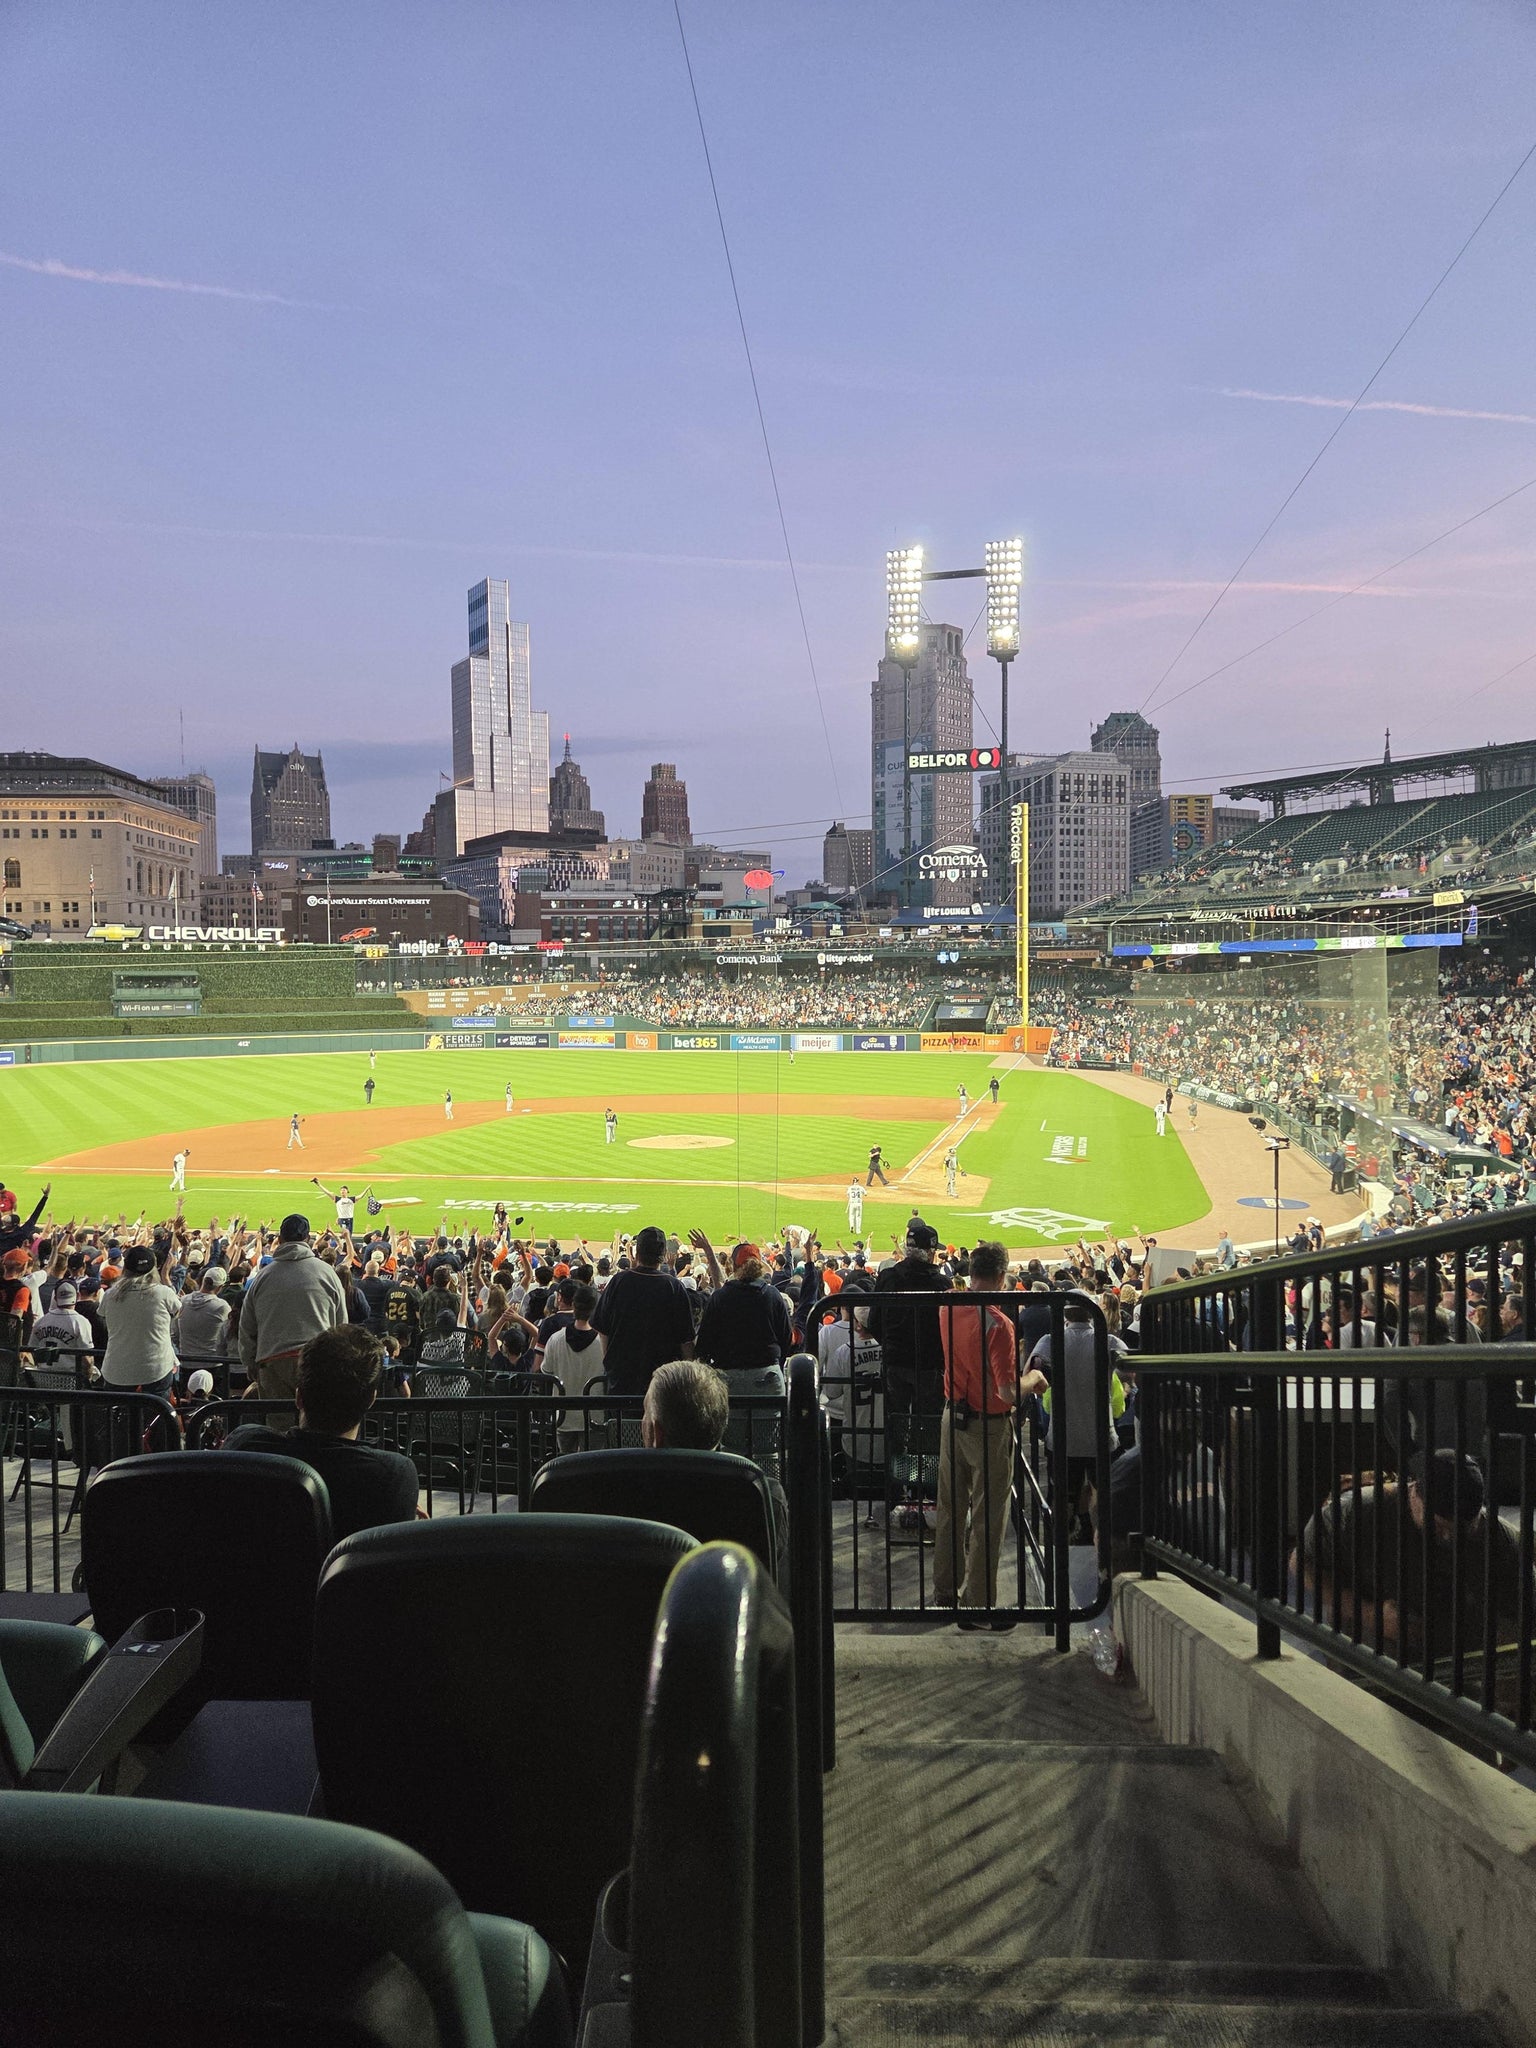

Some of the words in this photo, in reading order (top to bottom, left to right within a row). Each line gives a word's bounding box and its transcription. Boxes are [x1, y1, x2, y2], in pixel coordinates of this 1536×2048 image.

[909, 753, 968, 768] BELFOR
[1011, 819, 1022, 865] Rocket
[269, 862, 289, 871] Ashley
[342, 897, 367, 905] VALLEY
[367, 897, 388, 905] STATE
[389, 897, 431, 905] UNIVERSITY
[940, 907, 971, 916] LOUNGE
[1276, 906, 1297, 916] CLUB
[149, 926, 285, 941] CHEVROLET
[122, 943, 266, 951] FOUNTAIN
[399, 940, 441, 956] meijer
[546, 949, 564, 957] LAW
[759, 953, 783, 963] Bank
[446, 1035, 483, 1043] FERRIS
[635, 1036, 649, 1047] hop
[674, 1037, 717, 1048] bet365
[747, 1036, 776, 1044] McLaren
[802, 1037, 832, 1050] meijer
[923, 1038, 951, 1047] PIZZA
[851, 1191, 860, 1199] 34
[444, 1199, 641, 1210] VICTORS
[388, 1302, 408, 1321] 24
